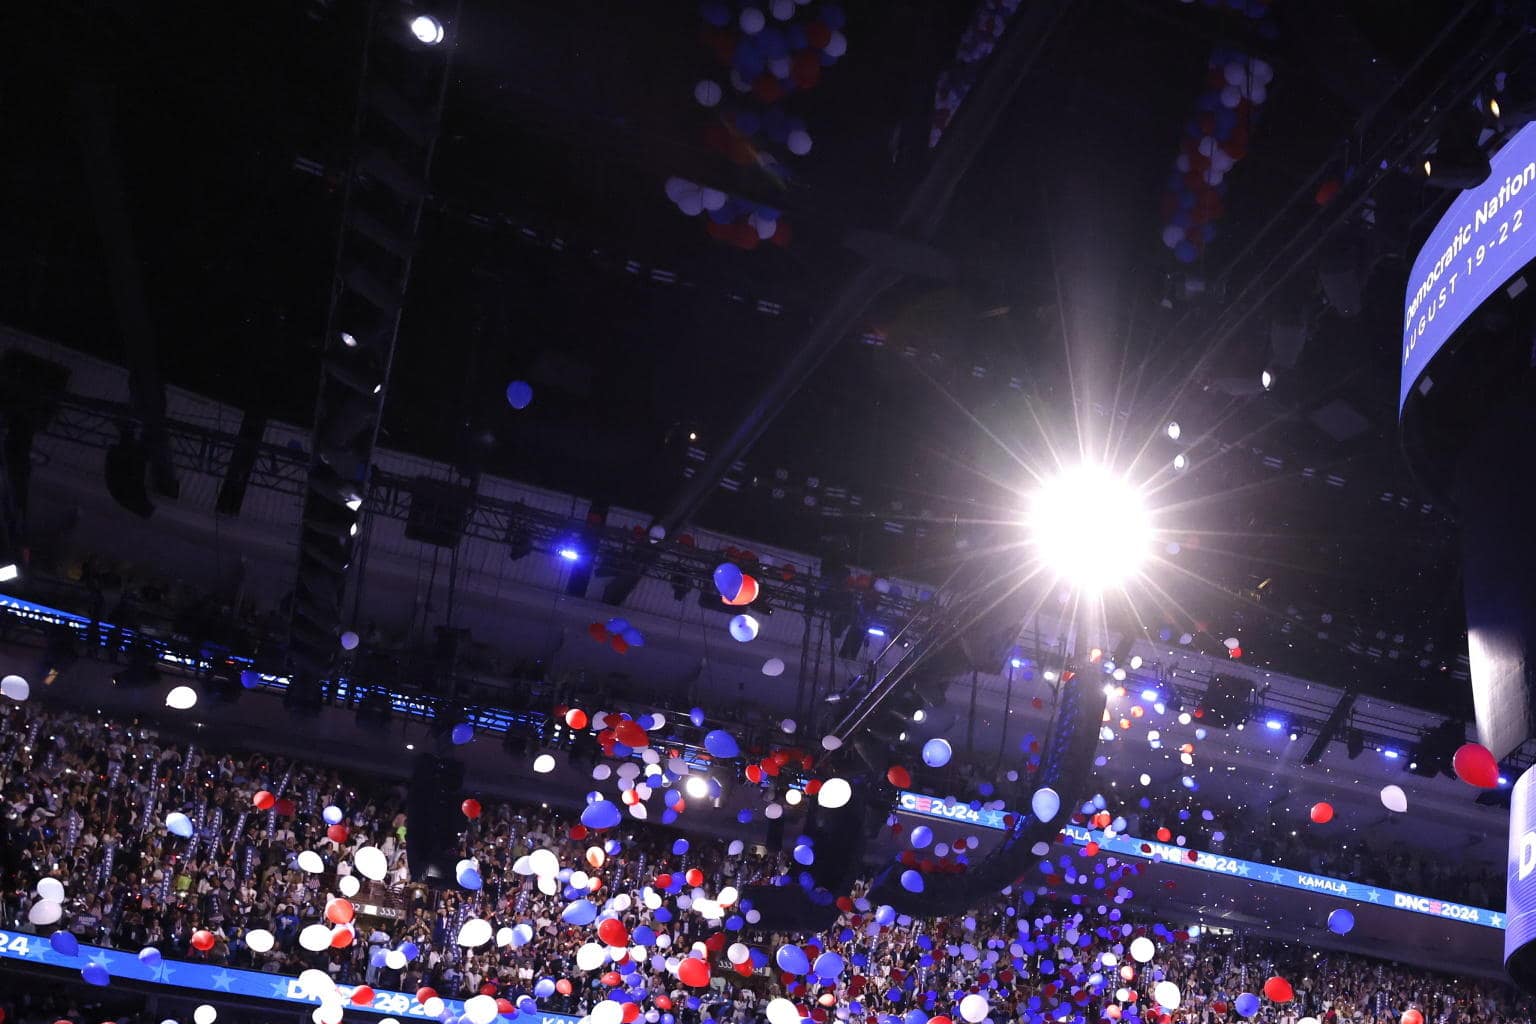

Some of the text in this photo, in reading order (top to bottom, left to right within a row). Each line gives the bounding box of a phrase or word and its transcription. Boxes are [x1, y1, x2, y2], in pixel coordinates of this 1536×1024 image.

[1403, 272, 1459, 366] AUGUST
[1466, 208, 1523, 276] 19-22
[1404, 222, 1472, 332] Democratic
[1298, 874, 1348, 895] KAMALA
[1394, 893, 1479, 923] DNC 2024
[0, 935, 29, 956] 24
